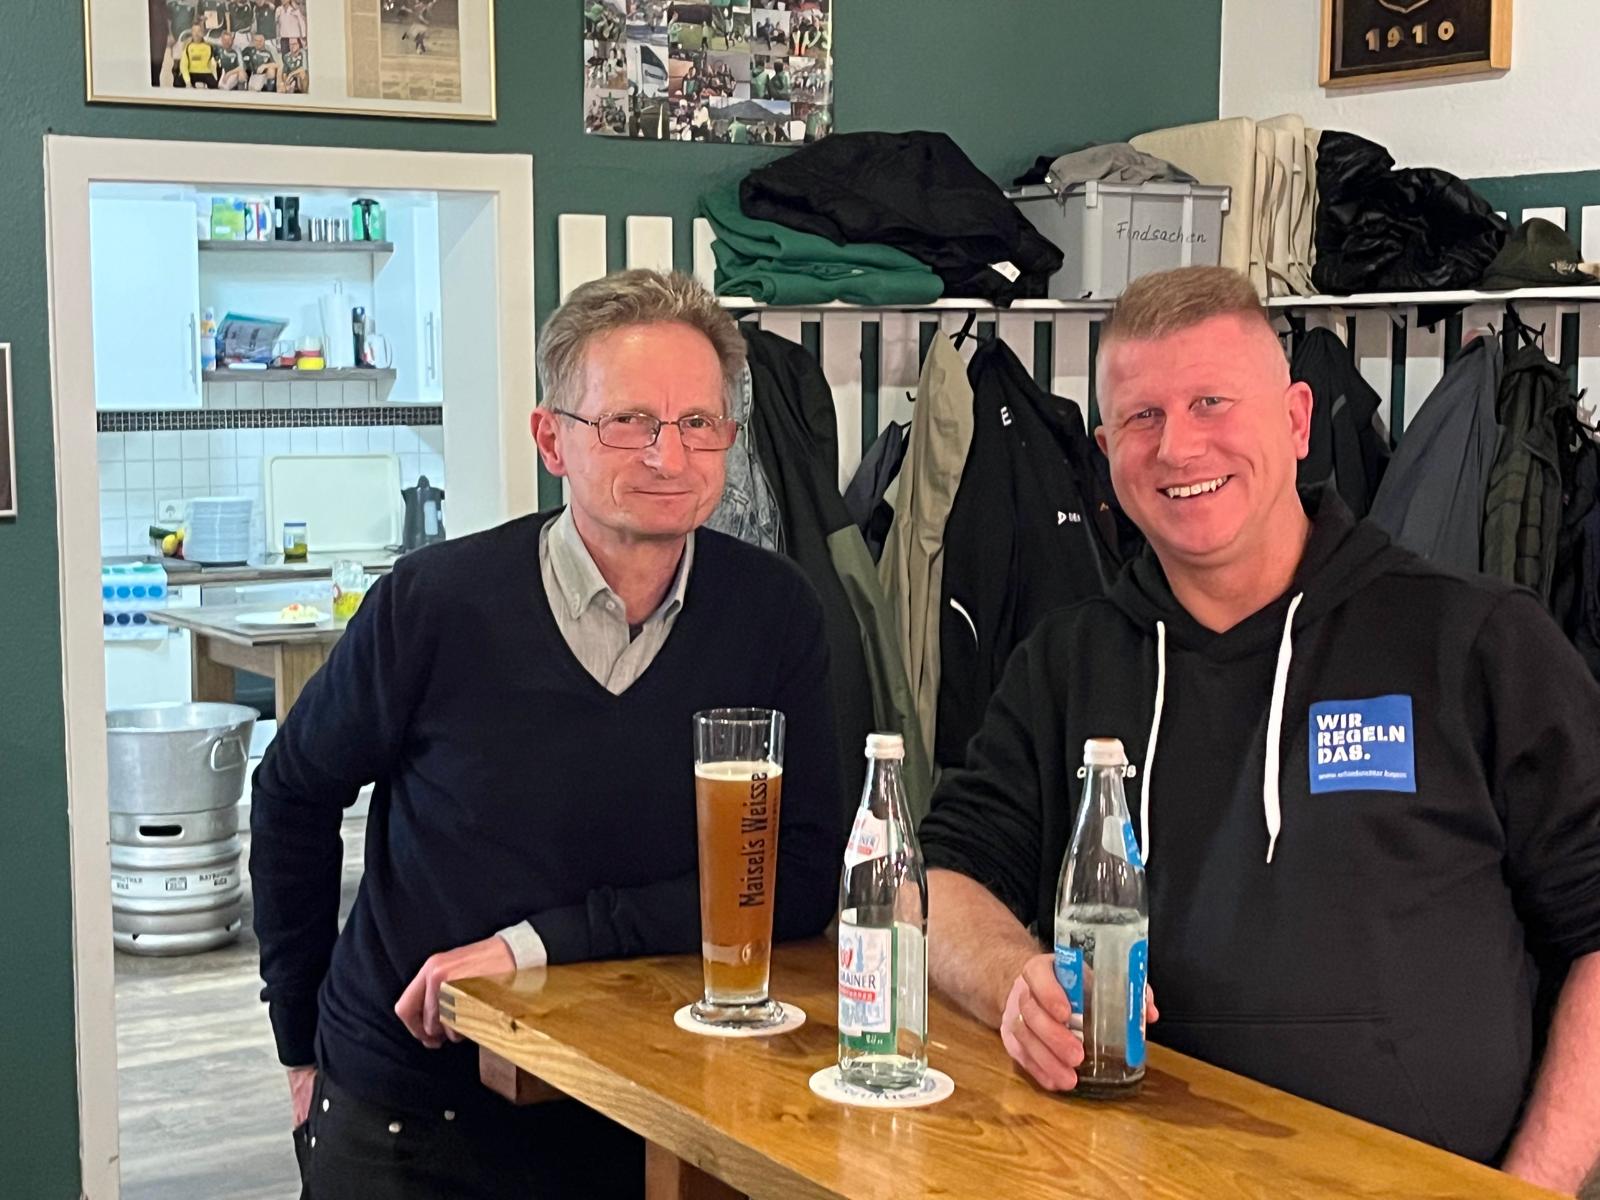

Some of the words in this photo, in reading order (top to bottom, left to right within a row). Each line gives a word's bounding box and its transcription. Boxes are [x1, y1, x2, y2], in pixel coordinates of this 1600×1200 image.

[1365, 20, 1456, 52] 1910
[1316, 713, 1363, 731] WIR
[1317, 725, 1406, 747] REGELN
[1317, 744, 1372, 765] DAS.
[741, 772, 768, 834] Weisse
[738, 838, 766, 908] Maisel's
